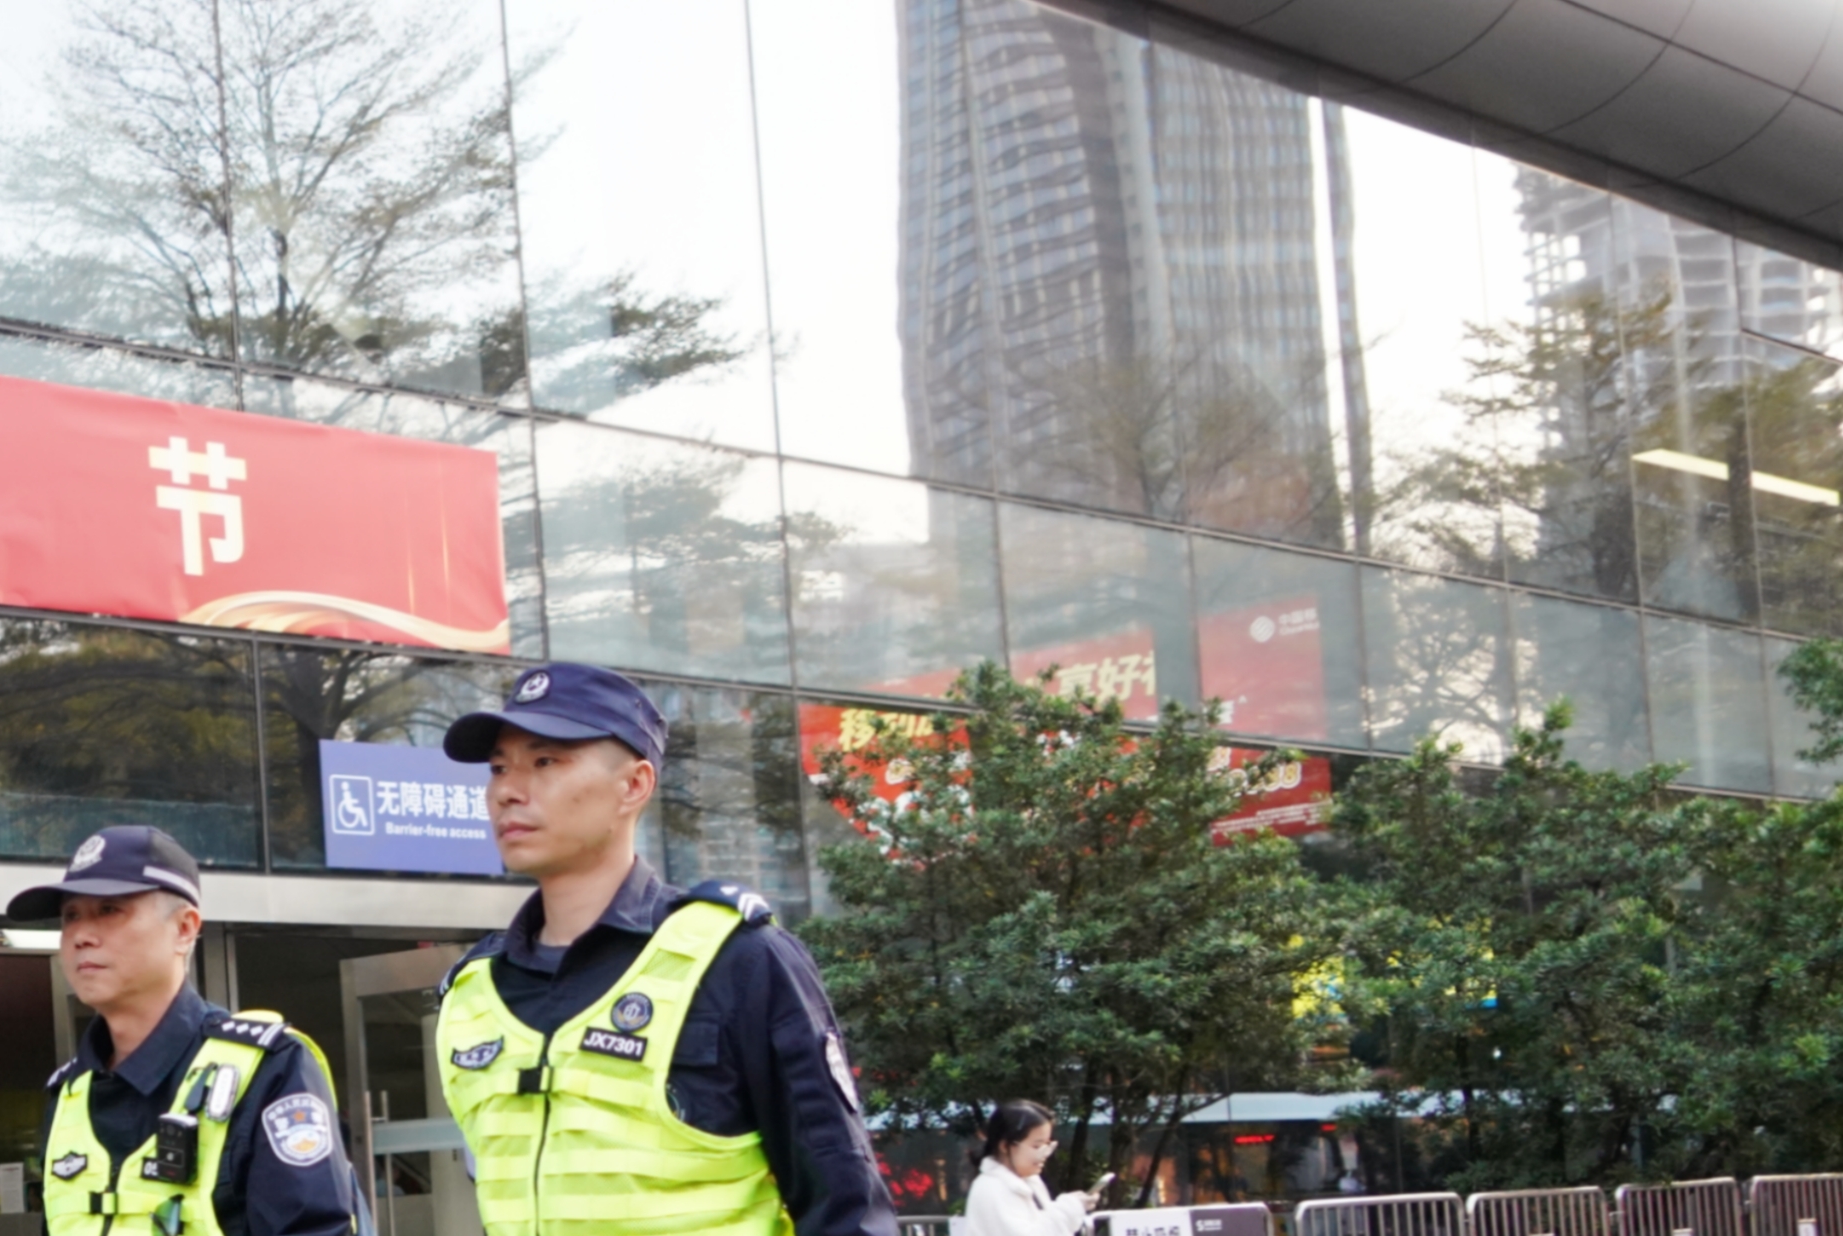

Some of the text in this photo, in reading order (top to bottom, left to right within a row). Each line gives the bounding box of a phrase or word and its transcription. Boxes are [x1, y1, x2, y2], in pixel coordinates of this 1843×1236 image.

[376, 780, 490, 821] 无障碍通道
[385, 821, 487, 840] Barrier-free access
[583, 1031, 643, 1056] JX7301
